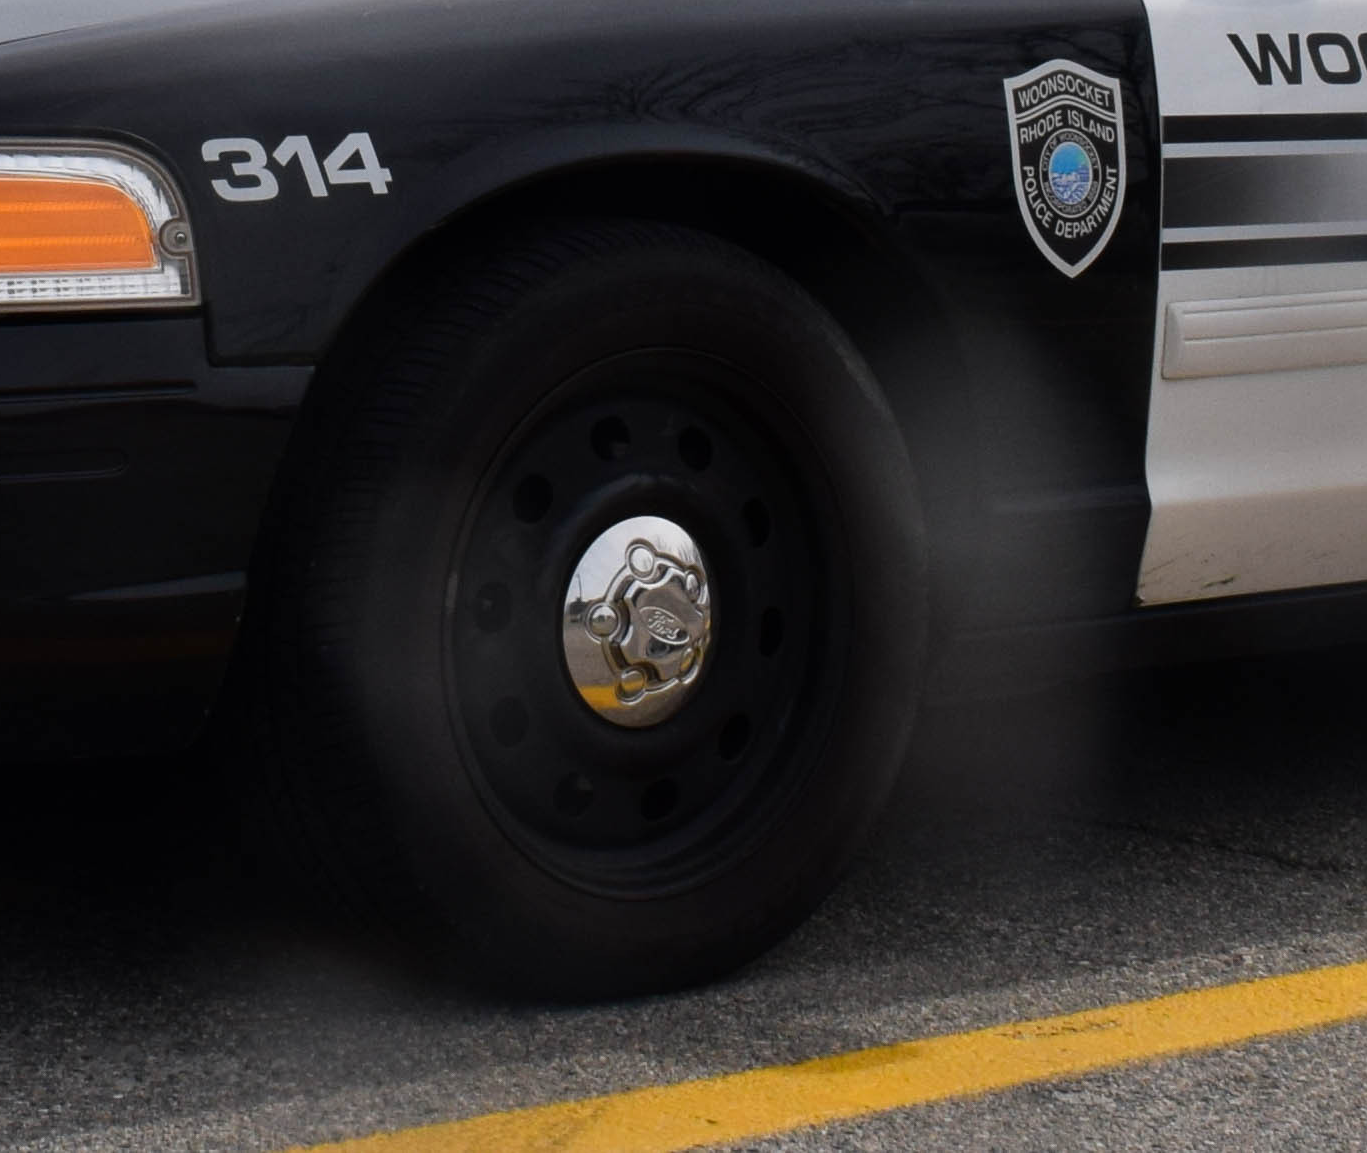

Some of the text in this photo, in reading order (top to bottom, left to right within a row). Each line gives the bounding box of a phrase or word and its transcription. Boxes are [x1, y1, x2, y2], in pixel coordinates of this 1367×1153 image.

[1017, 73, 1111, 109] WOONSOCKET
[1019, 109, 1115, 144] RHODE ISLAND
[201, 132, 393, 202] 314
[1022, 165, 1119, 239] POLICE DEPARTMENT
